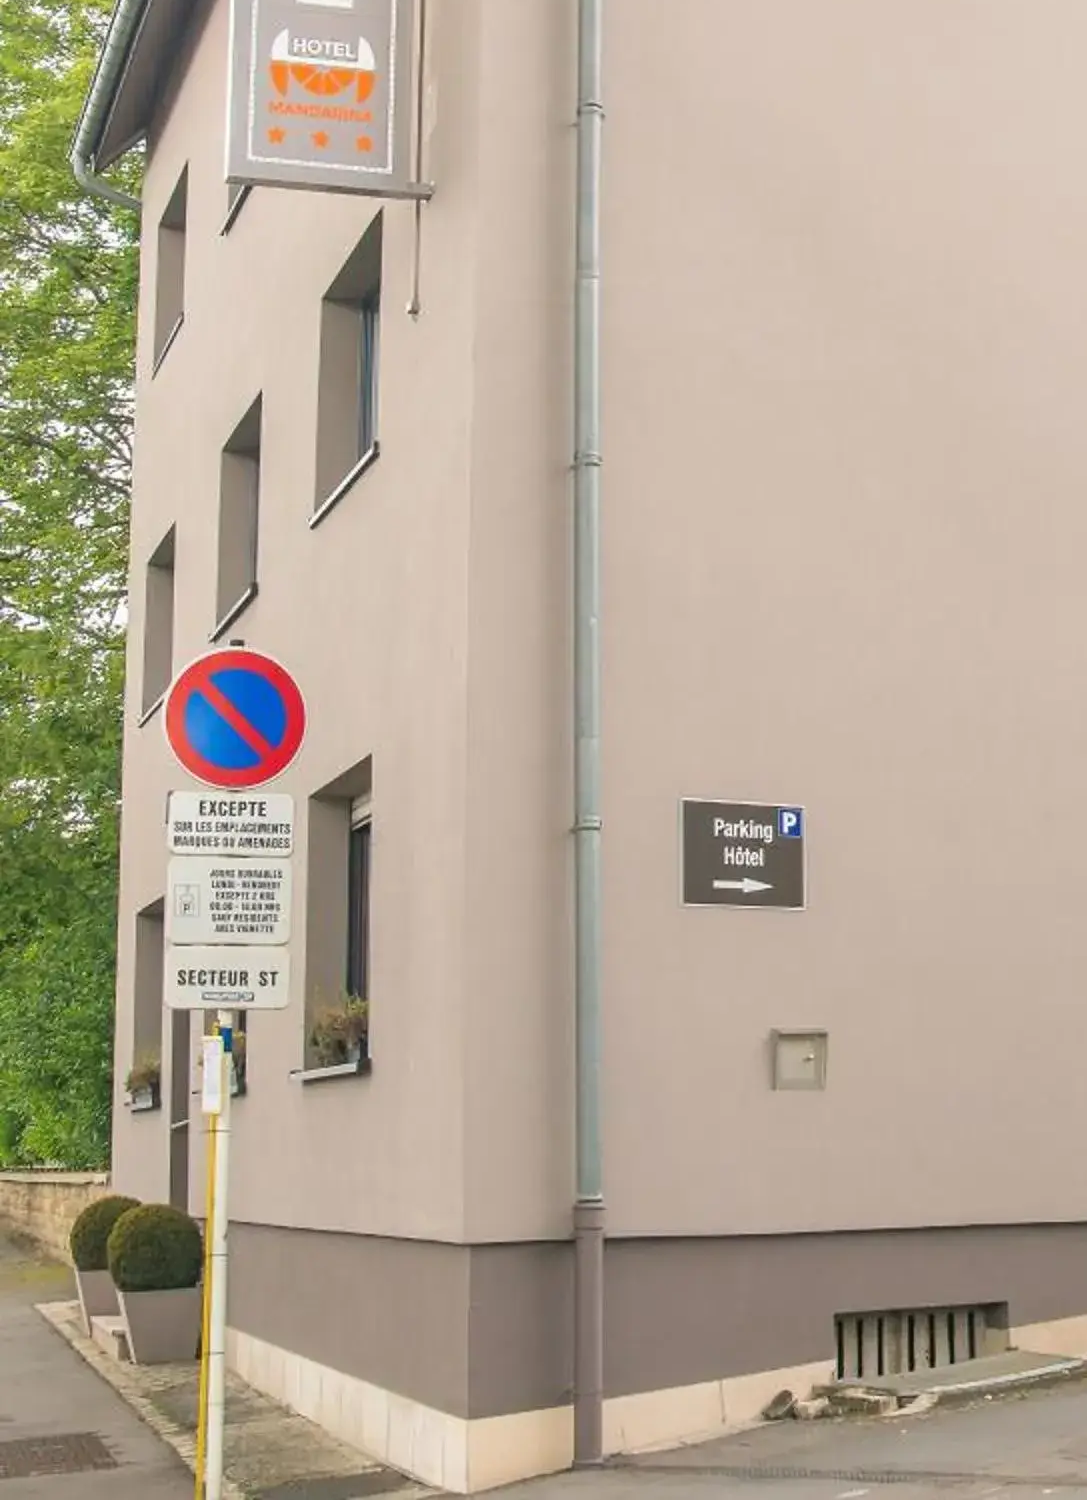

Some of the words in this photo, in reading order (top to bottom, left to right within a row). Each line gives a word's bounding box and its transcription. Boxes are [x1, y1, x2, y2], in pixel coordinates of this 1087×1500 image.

[293, 38, 357, 58] HOTEL
[199, 800, 268, 817] EXCEPTE
[196, 822, 213, 833] LES
[713, 817, 773, 843] Parking
[782, 811, 797, 834] P
[724, 846, 764, 867] Hôtel
[177, 969, 249, 987] SECTEUR
[258, 970, 279, 987] ST
